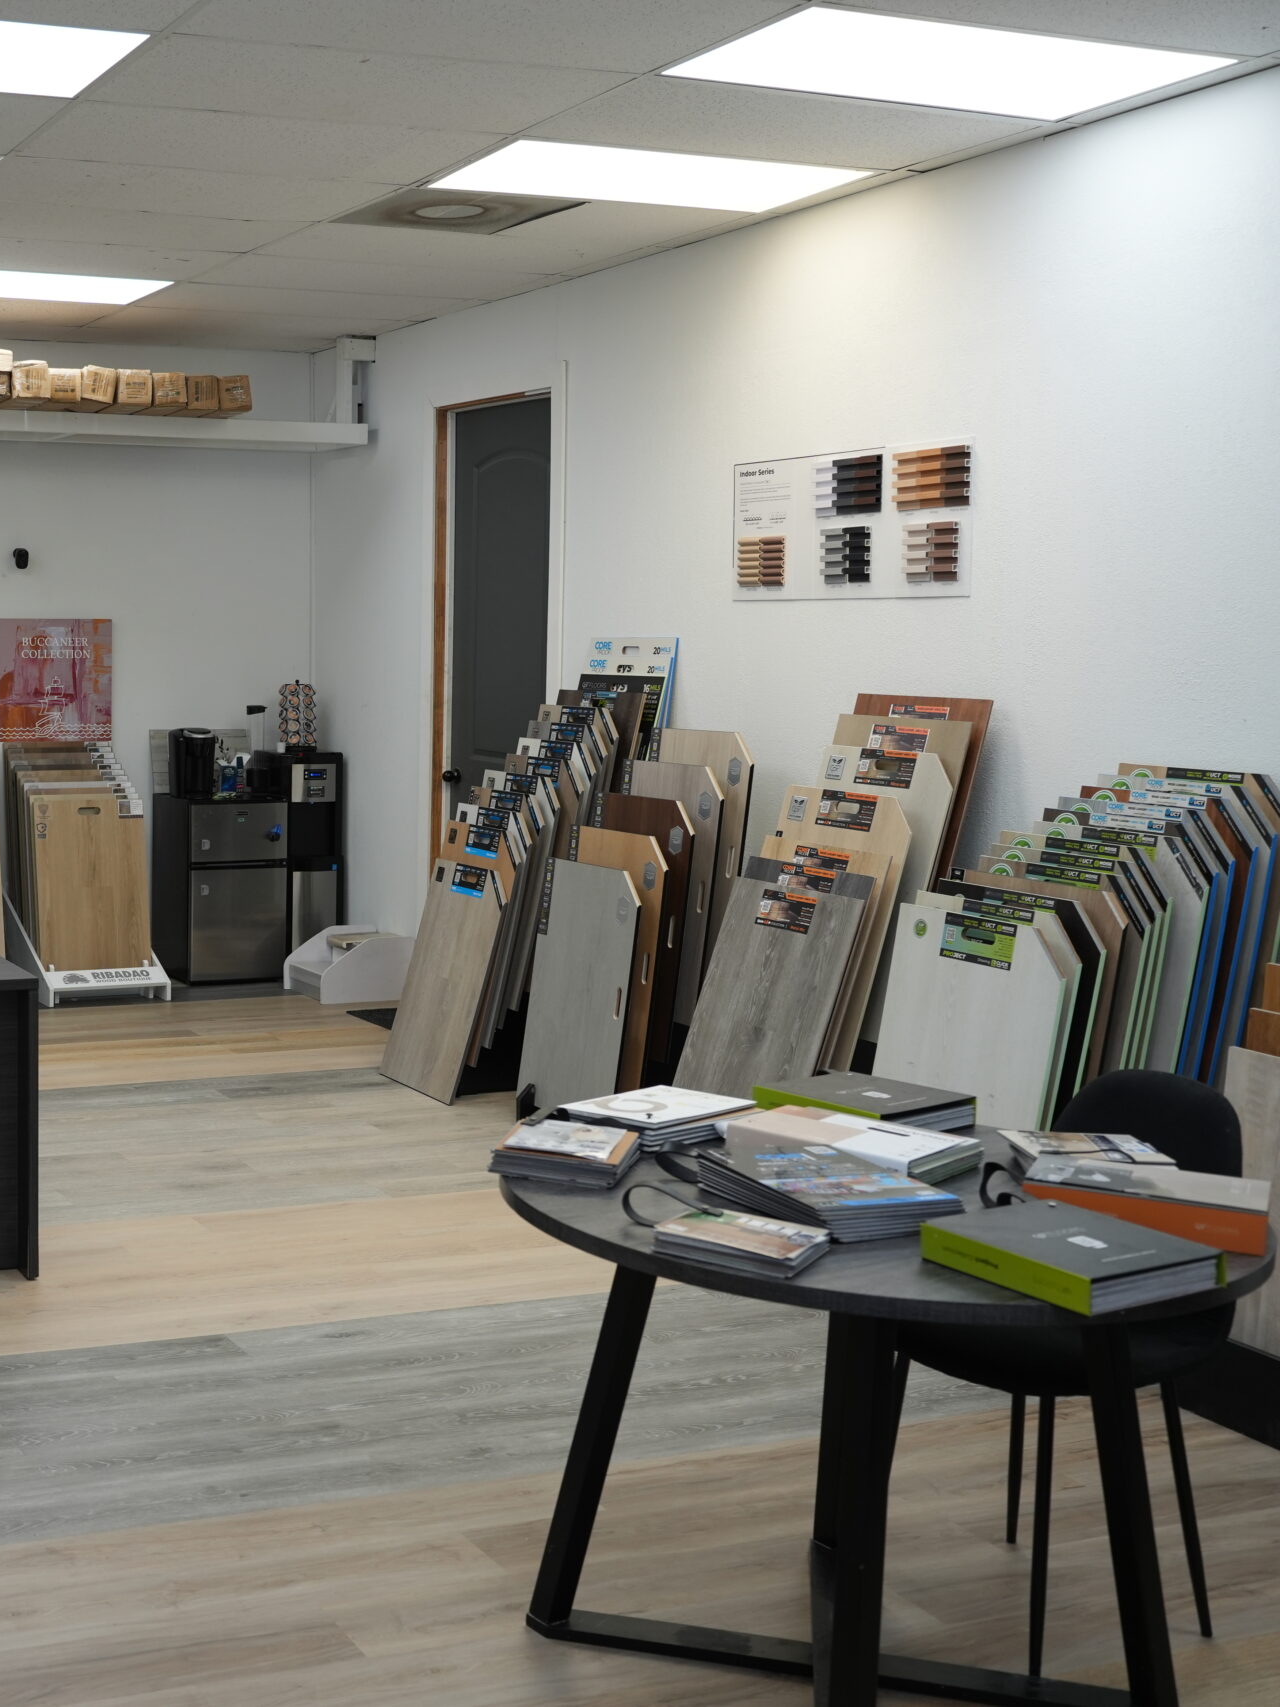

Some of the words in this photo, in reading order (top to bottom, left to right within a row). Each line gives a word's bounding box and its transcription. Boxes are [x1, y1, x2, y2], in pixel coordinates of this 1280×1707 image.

[739, 470, 757, 478] Indoor
[758, 468, 775, 476] Series
[21, 637, 88, 647] BUCCANEER
[595, 641, 613, 650] CORE
[21, 649, 91, 659] COLLECTION
[590, 659, 608, 668] CORE
[942, 950, 966, 960] PROJECT
[91, 969, 150, 980] RIBADAO
